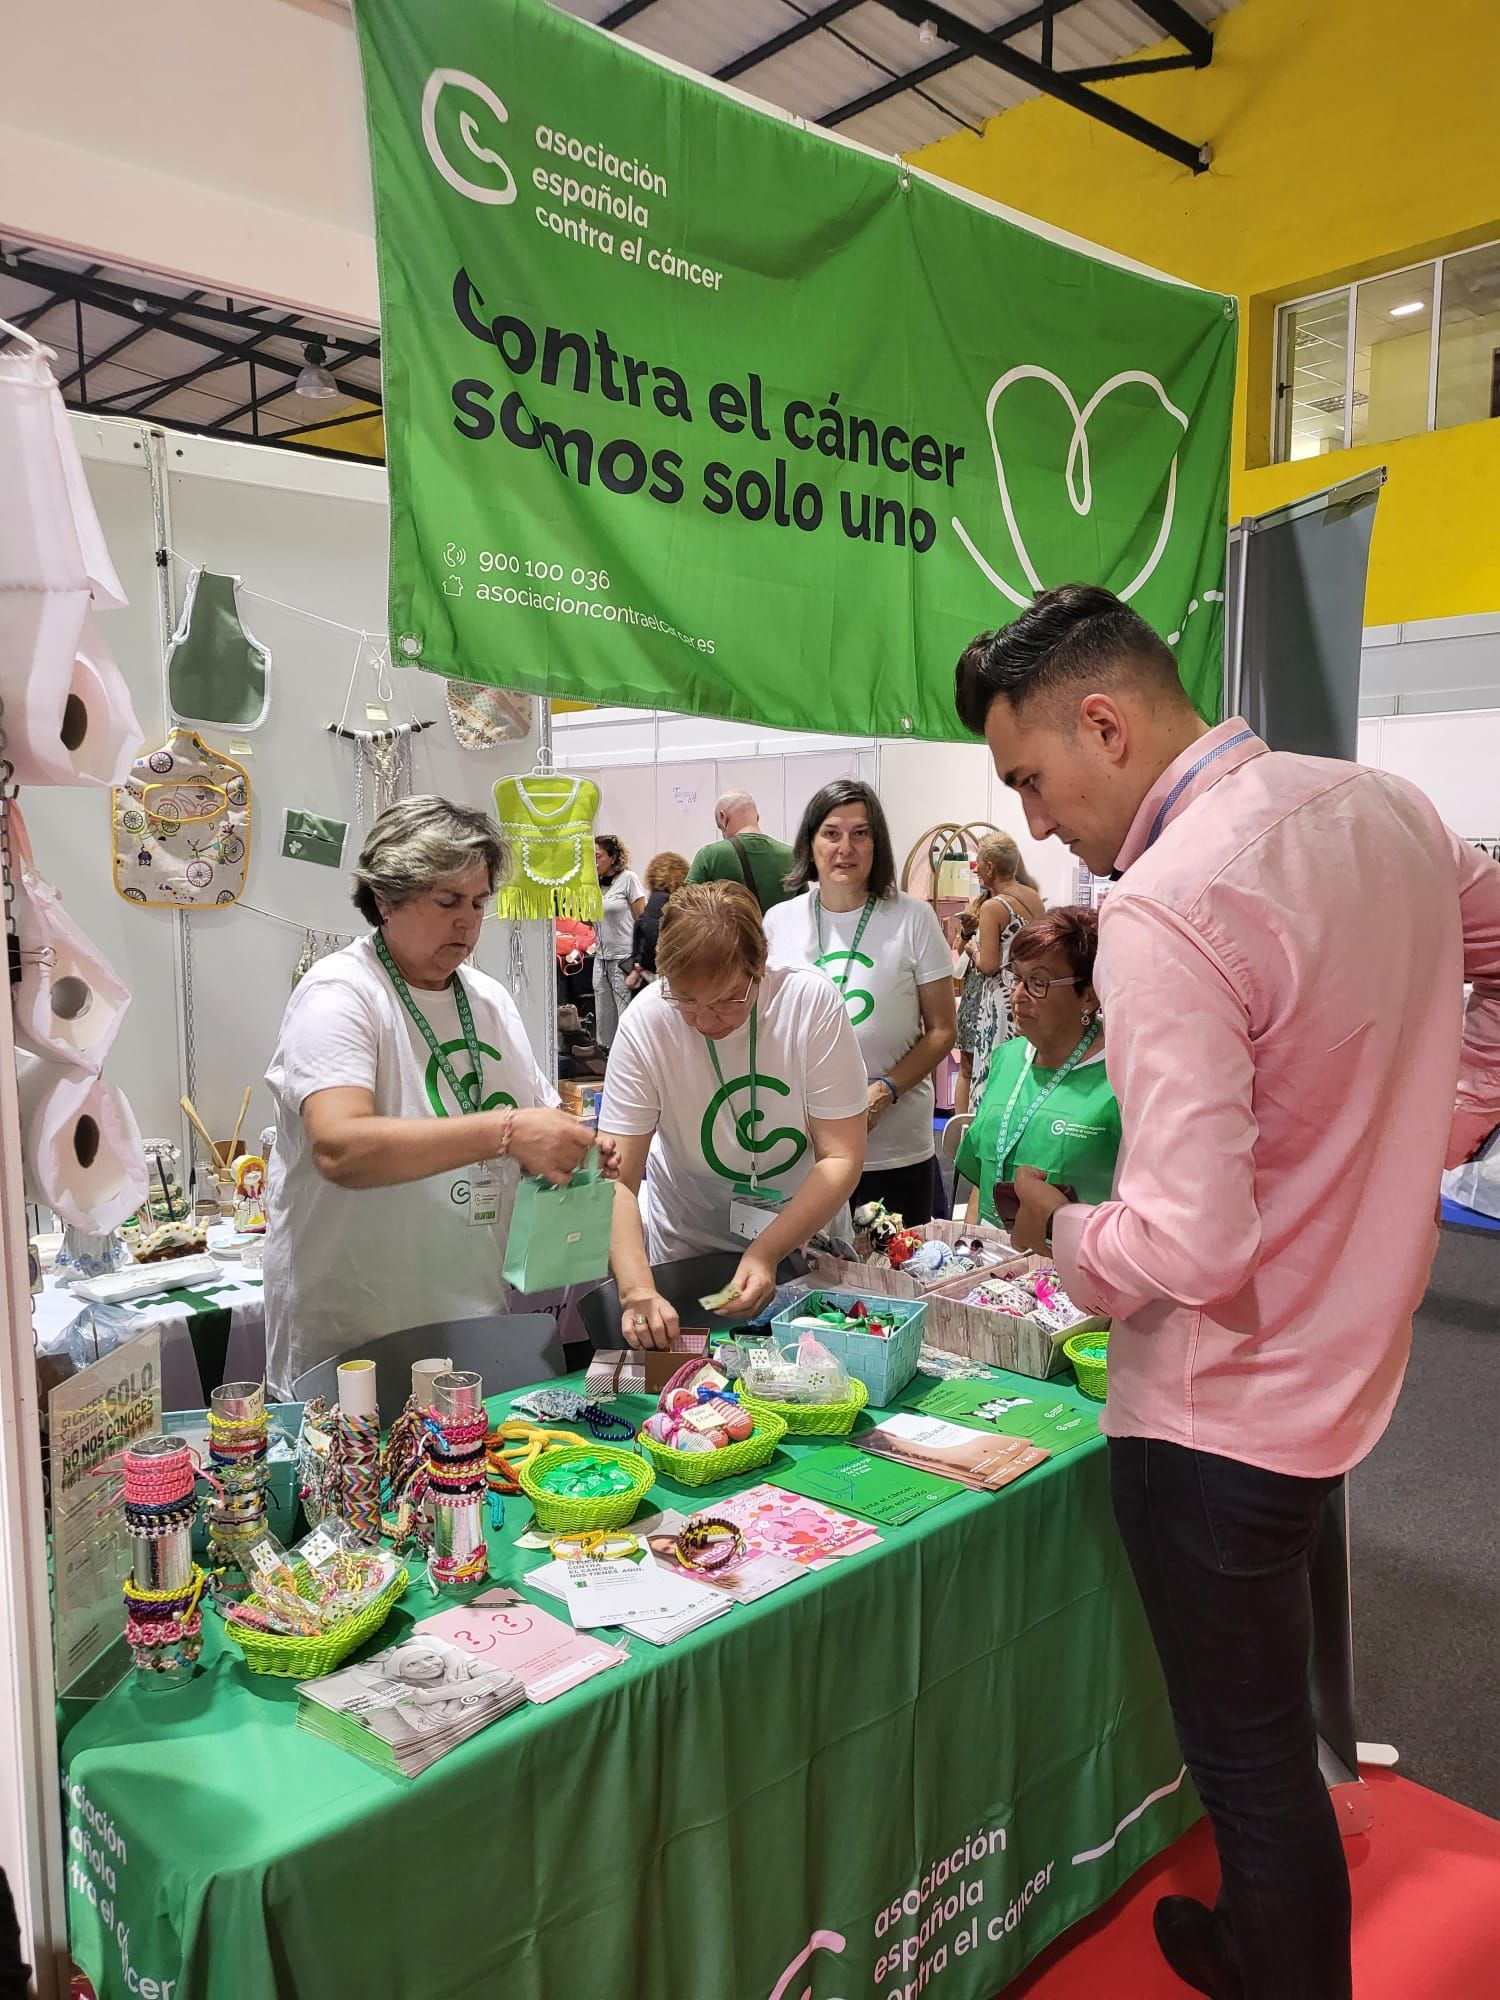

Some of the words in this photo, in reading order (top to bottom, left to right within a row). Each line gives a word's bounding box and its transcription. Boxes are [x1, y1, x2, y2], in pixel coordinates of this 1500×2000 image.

[531, 166, 650, 229] española
[534, 124, 668, 198] asociación
[534, 205, 614, 255] contra
[620, 236, 642, 265] el
[647, 247, 724, 291] cáncer
[452, 266, 693, 423] Contra
[708, 372, 771, 441] el
[783, 391, 966, 488] cáncer
[450, 377, 685, 505] somos
[702, 457, 824, 532] solo
[839, 489, 937, 554] uno
[478, 551, 520, 573] 900
[523, 560, 564, 581] 100
[570, 568, 611, 591] 036
[62, 1448, 80, 1474] NO
[81, 1429, 104, 1457] NOS
[106, 1394, 154, 1440] CONOCES
[70, 1859, 97, 1908] tra
[100, 1898, 114, 1931] el
[874, 1826, 1007, 1938] asociación
[954, 1917, 980, 1958] el
[986, 1859, 1055, 1943] cáncer
[873, 1877, 984, 1985] española
